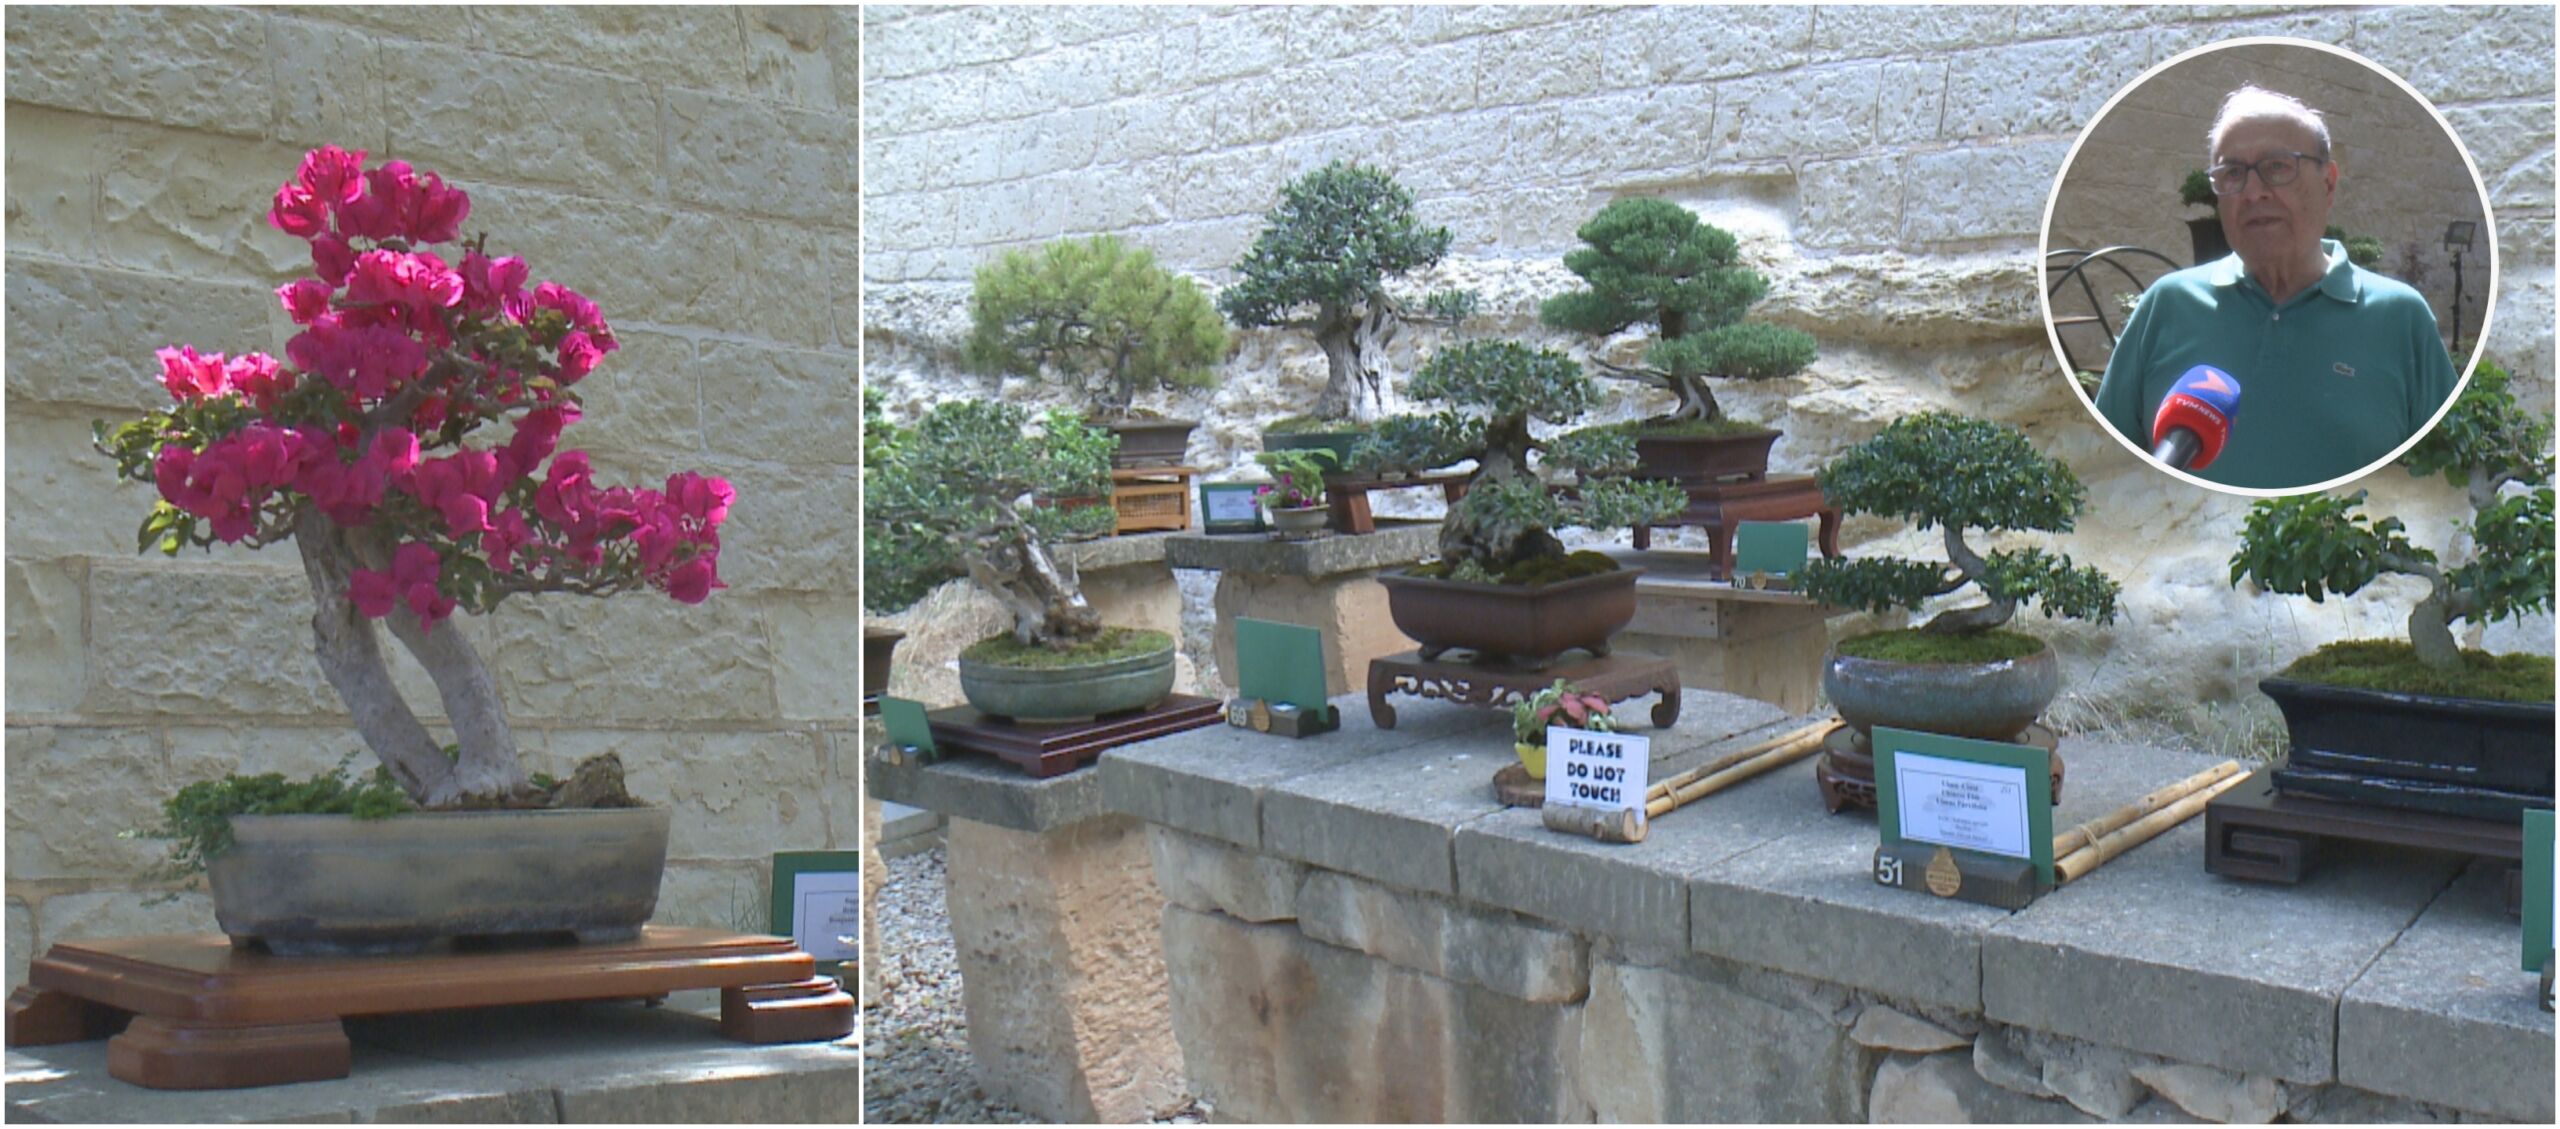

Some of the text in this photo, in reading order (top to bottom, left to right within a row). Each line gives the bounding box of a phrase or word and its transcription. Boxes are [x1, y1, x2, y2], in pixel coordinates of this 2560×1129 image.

[1733, 575, 1746, 589] 70
[1569, 738, 1623, 759] PLEASE
[1567, 761, 1626, 783] DO NOT
[1569, 782, 1621, 804] TOUCH
[1877, 855, 1903, 886] 51
